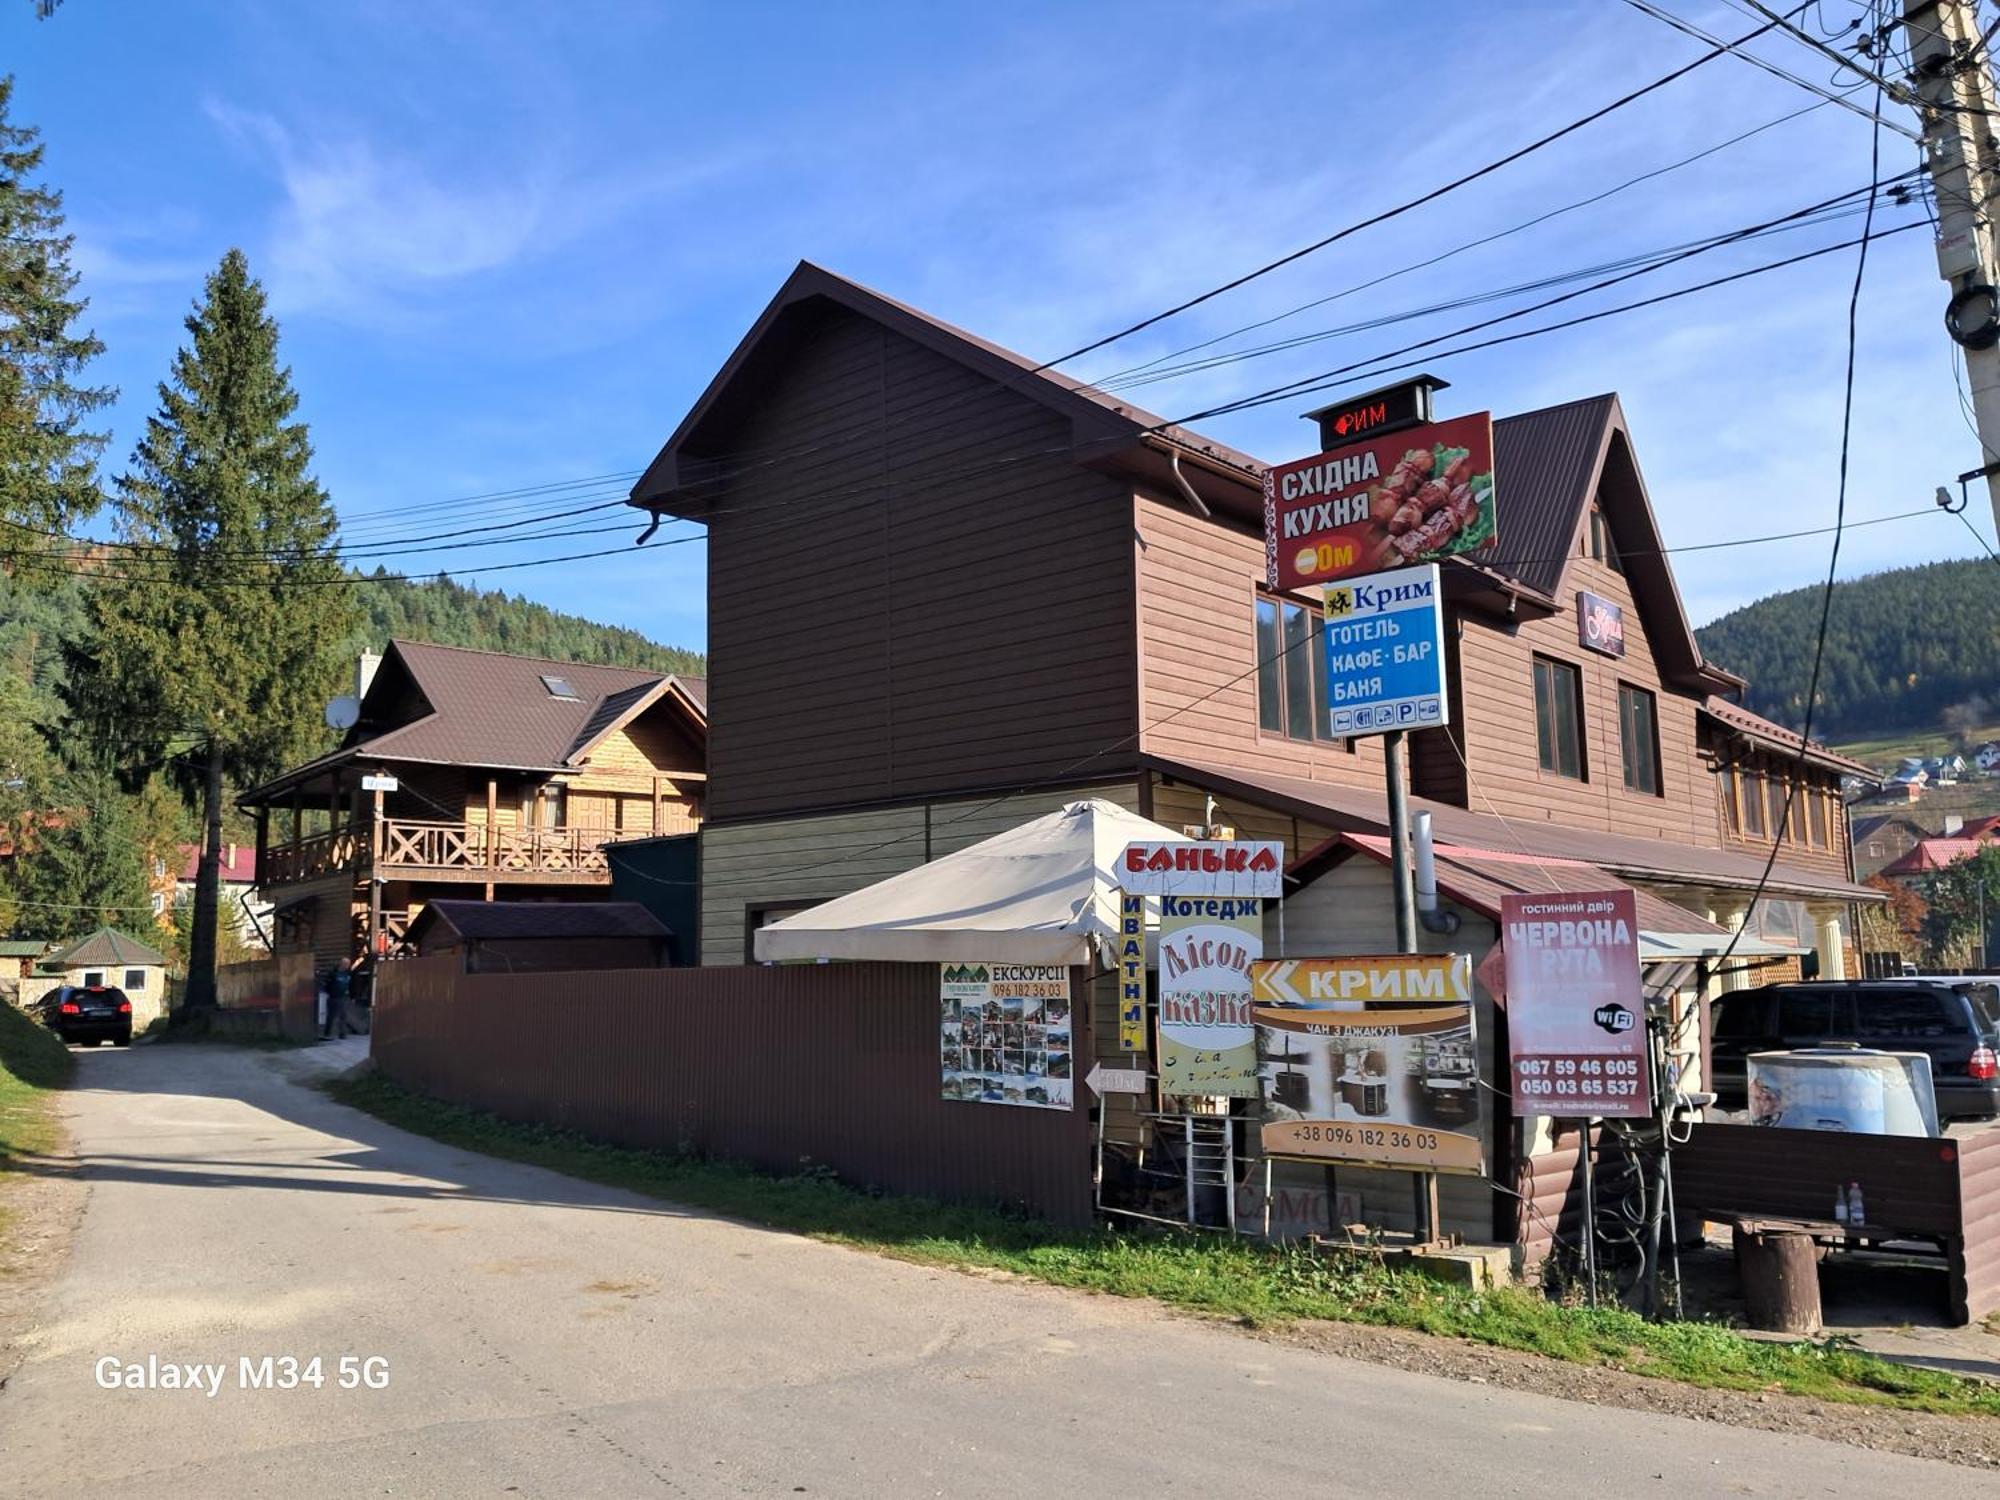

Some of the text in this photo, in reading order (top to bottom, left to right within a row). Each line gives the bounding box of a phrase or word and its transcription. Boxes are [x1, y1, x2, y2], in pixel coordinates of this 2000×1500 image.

[1281, 451, 1380, 501] СХІДНА
[1283, 493, 1369, 539] КУХНЯ
[1353, 581, 1432, 612] Крим
[1330, 620, 1400, 646] ГОТЕЛЬ
[1332, 641, 1431, 674] КАФЕ БАР
[1334, 677, 1382, 701] БАНЯ
[1125, 847, 1279, 874] БАНЬКА
[1162, 897, 1258, 920] Котедж
[1521, 900, 1614, 915] гостинний двір
[1510, 919, 1631, 947] ЧЕРВОНА
[1544, 949, 1603, 973] РУТА
[993, 984, 1011, 997] 096
[1014, 984, 1030, 997] 182
[1033, 984, 1045, 997] 36
[1048, 984, 1060, 997] 03
[1310, 969, 1445, 999] КРИМ
[1306, 1023, 1330, 1036] ЧАН
[1344, 1025, 1400, 1038] ДЖАКУЗІ
[1519, 1060, 1637, 1075] 067 59 46 605
[1520, 1079, 1638, 1095] 050 03 65 537
[1293, 1126, 1437, 1150] +38 096 182 36 03
